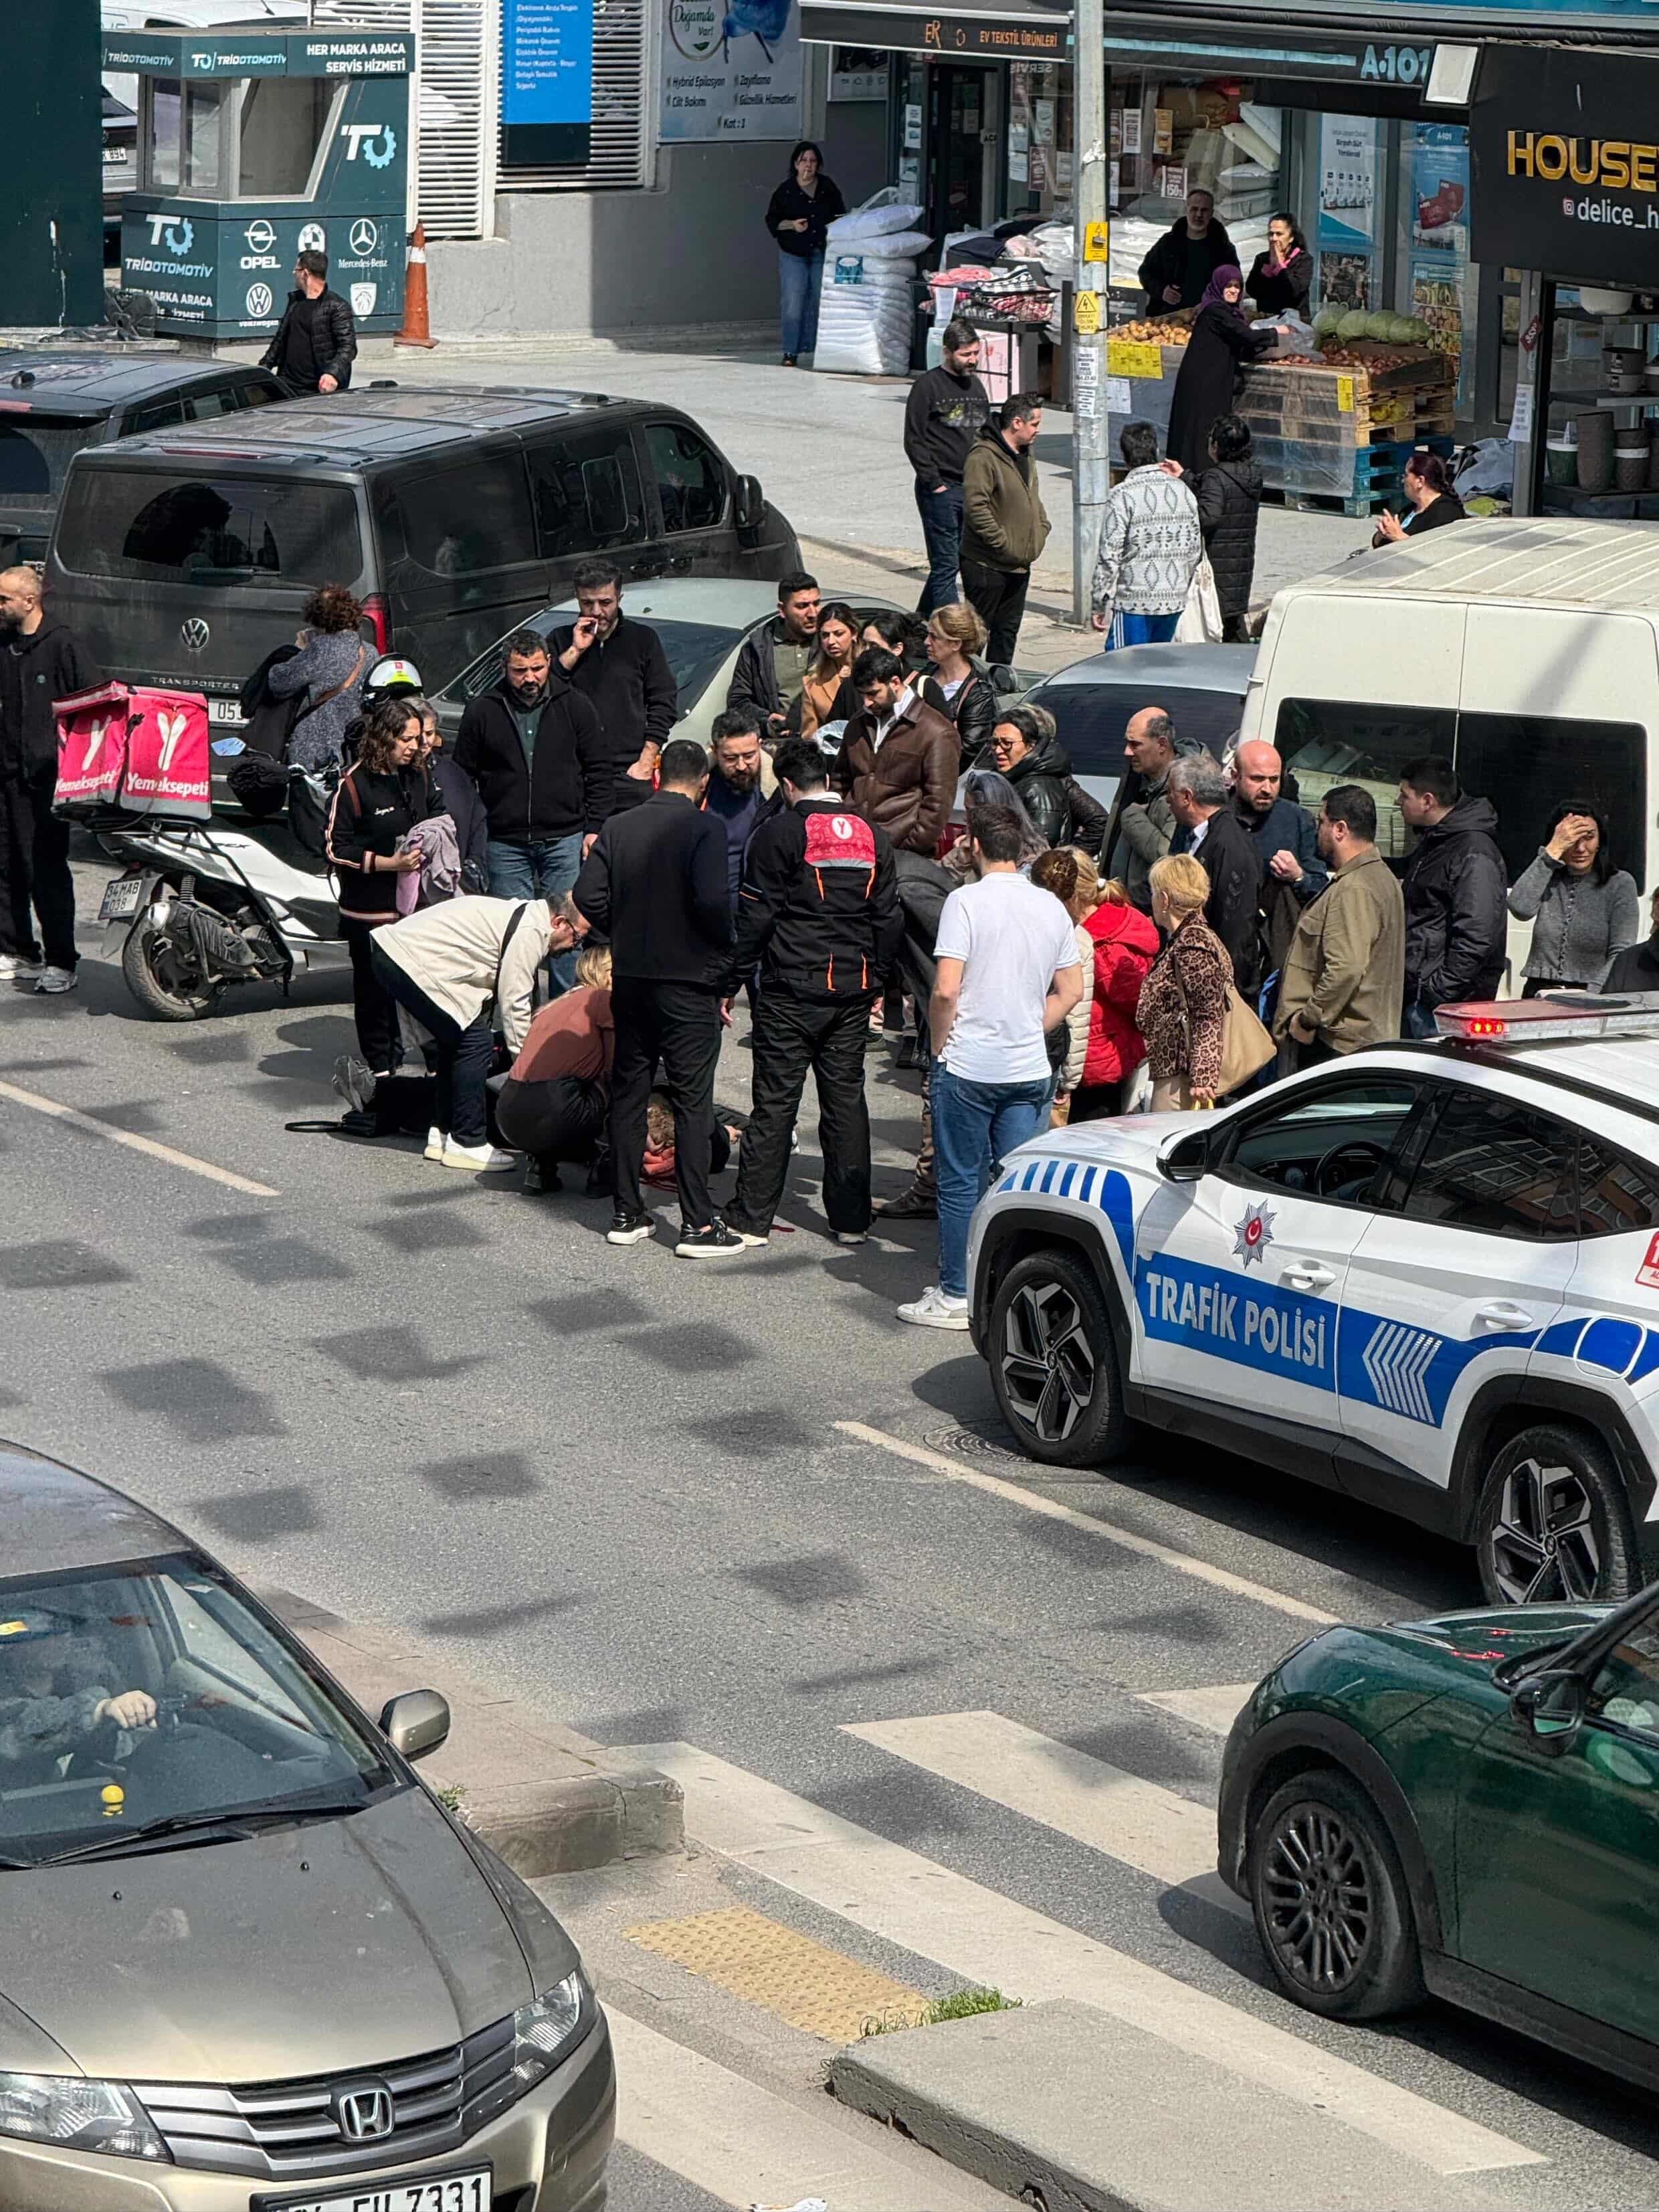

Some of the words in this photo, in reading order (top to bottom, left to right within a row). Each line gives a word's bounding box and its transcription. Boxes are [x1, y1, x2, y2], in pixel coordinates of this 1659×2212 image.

[979, 30, 989, 43] EV
[992, 29, 1019, 45] TEKSTİL
[1021, 30, 1058, 47] ÜRÜNLERİ
[307, 44, 328, 56] HER
[330, 43, 368, 55] MARKA
[369, 43, 406, 54] ARACA
[326, 59, 362, 72] SERVİS
[364, 58, 406, 72] HİZMETİ
[673, 76, 694, 90] Hybrid
[695, 76, 725, 89] Epilasyon
[1507, 130, 1658, 193] HOUSE
[240, 256, 281, 269] OPEL
[338, 258, 389, 268] Mercedes-Benz
[180, 294, 213, 307] ARACA
[151, 676, 239, 690] TRANSPORTER
[127, 773, 209, 796] Yemeksepeti
[1145, 1272, 1237, 1342] TRAFİK
[1244, 1300, 1325, 1370] POLİSİ
[406, 2177, 481, 2212] 7331
